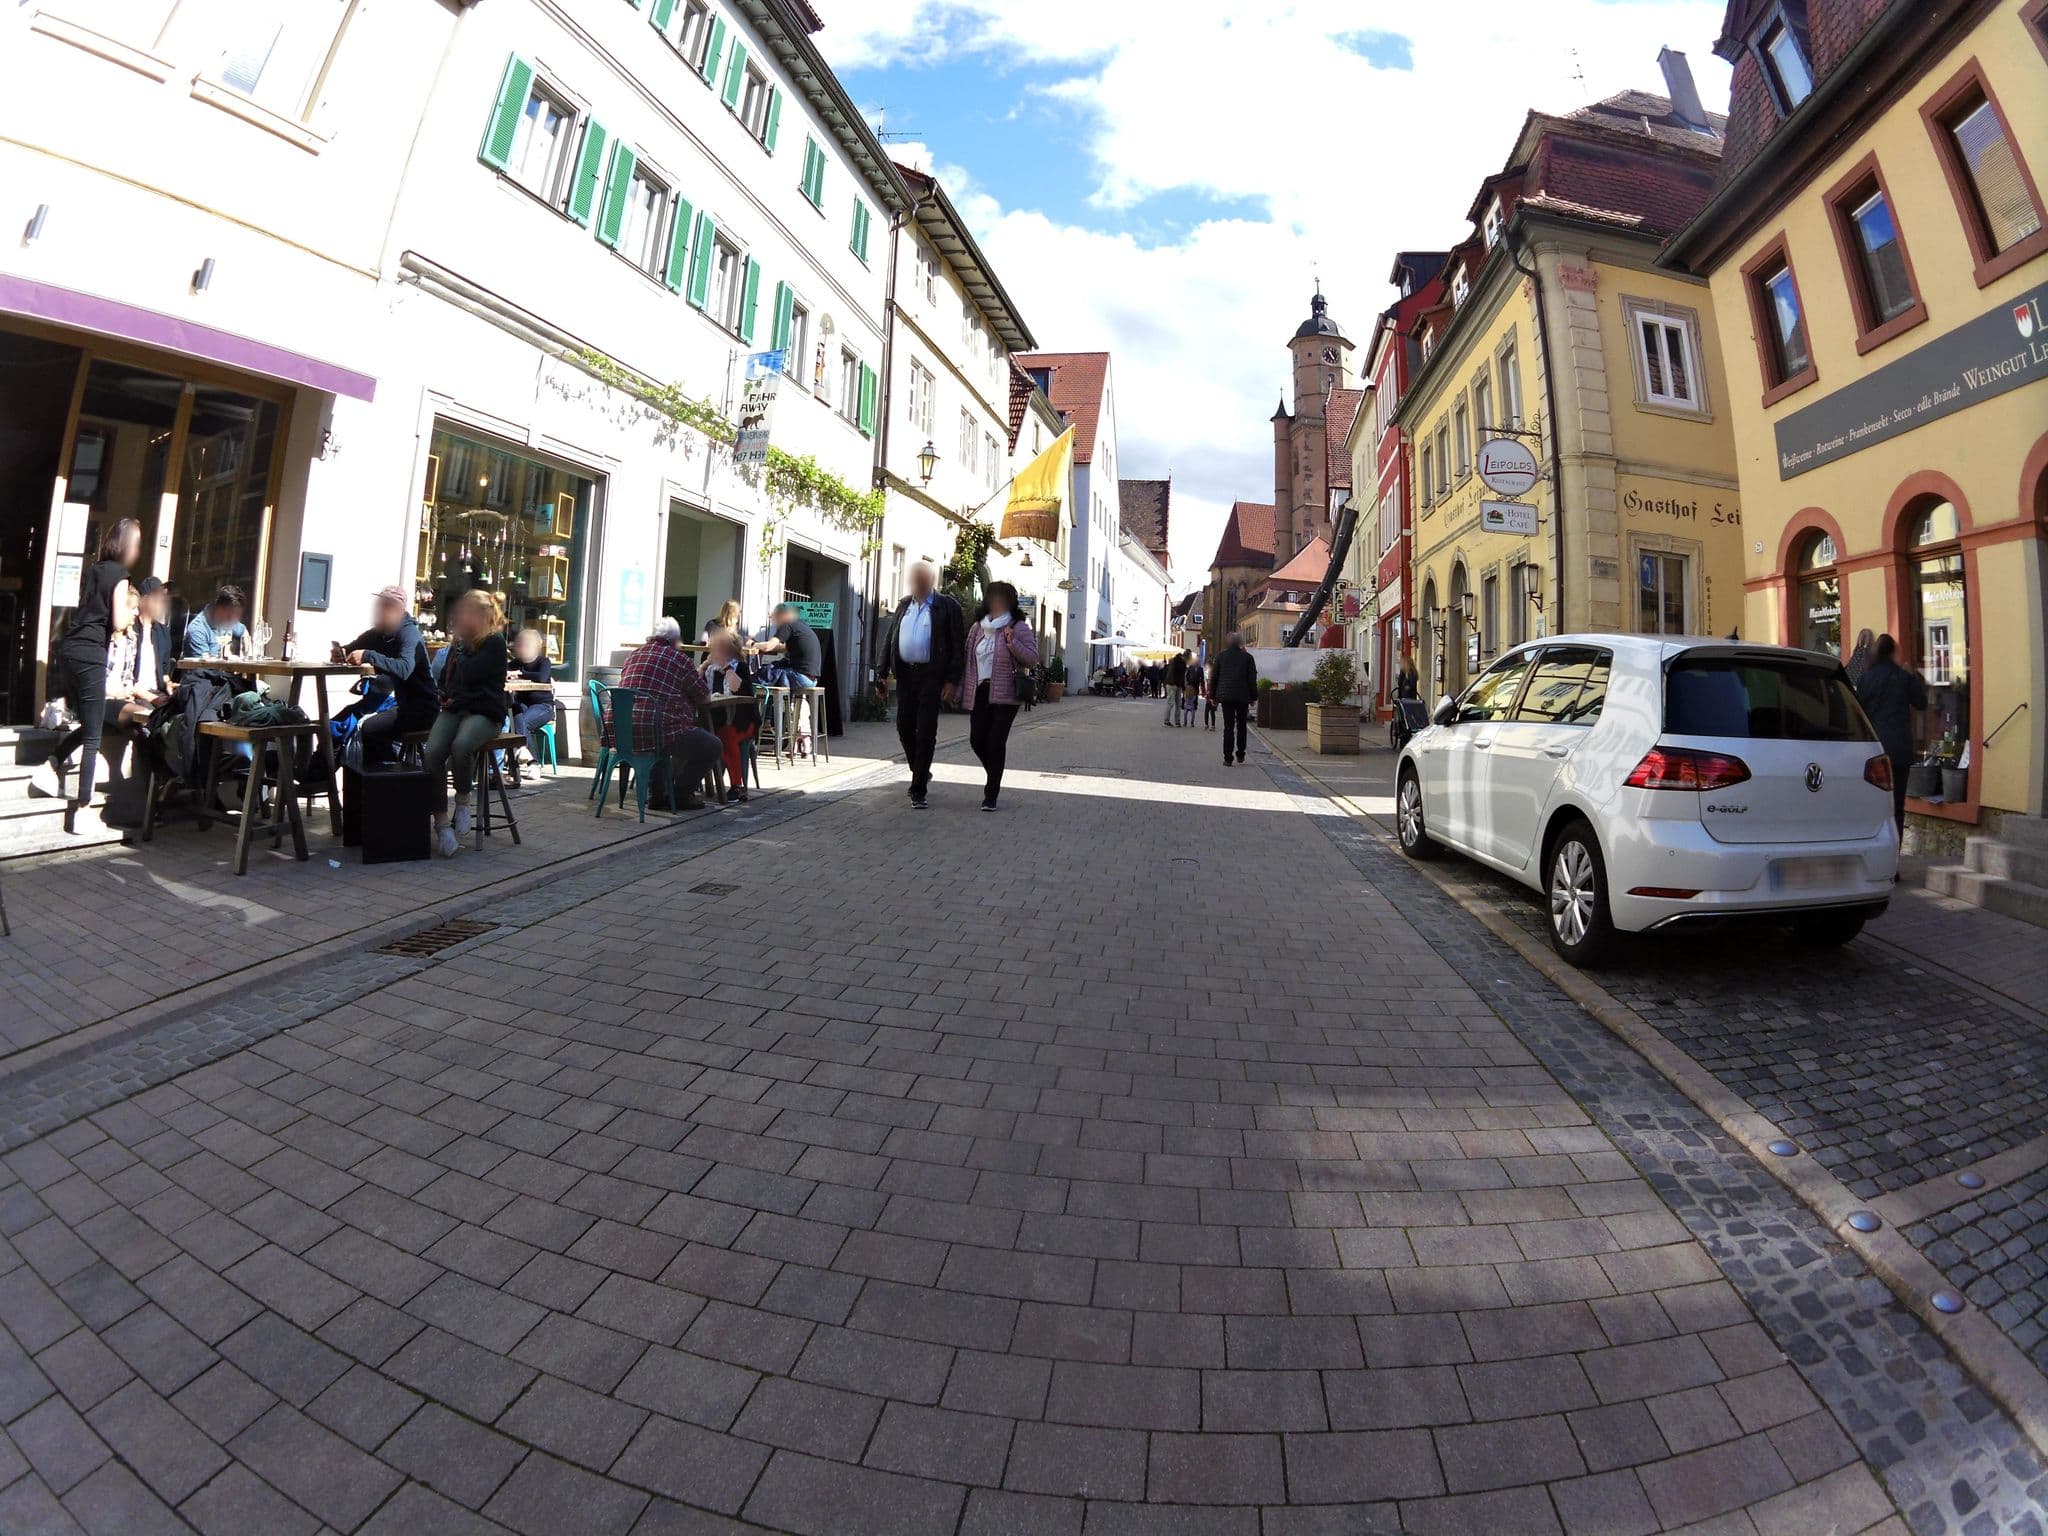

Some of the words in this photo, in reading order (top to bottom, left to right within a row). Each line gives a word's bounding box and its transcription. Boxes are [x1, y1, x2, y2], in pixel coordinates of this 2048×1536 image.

[749, 392, 777, 402] FAHR
[740, 402, 768, 413] AWAY
[1781, 449, 1812, 469] Weißweine
[1816, 435, 1845, 455] Rotweine
[1849, 415, 1889, 442] Frankensekt
[1893, 406, 1912, 423] Secco
[1917, 394, 1932, 413] edle
[1933, 382, 1961, 406] Brände
[1962, 351, 2027, 391] WEINGUT
[1485, 454, 1534, 476] LEIPOLDS
[1507, 508, 1531, 520] HOTEL
[1623, 490, 1698, 522] Gasthof
